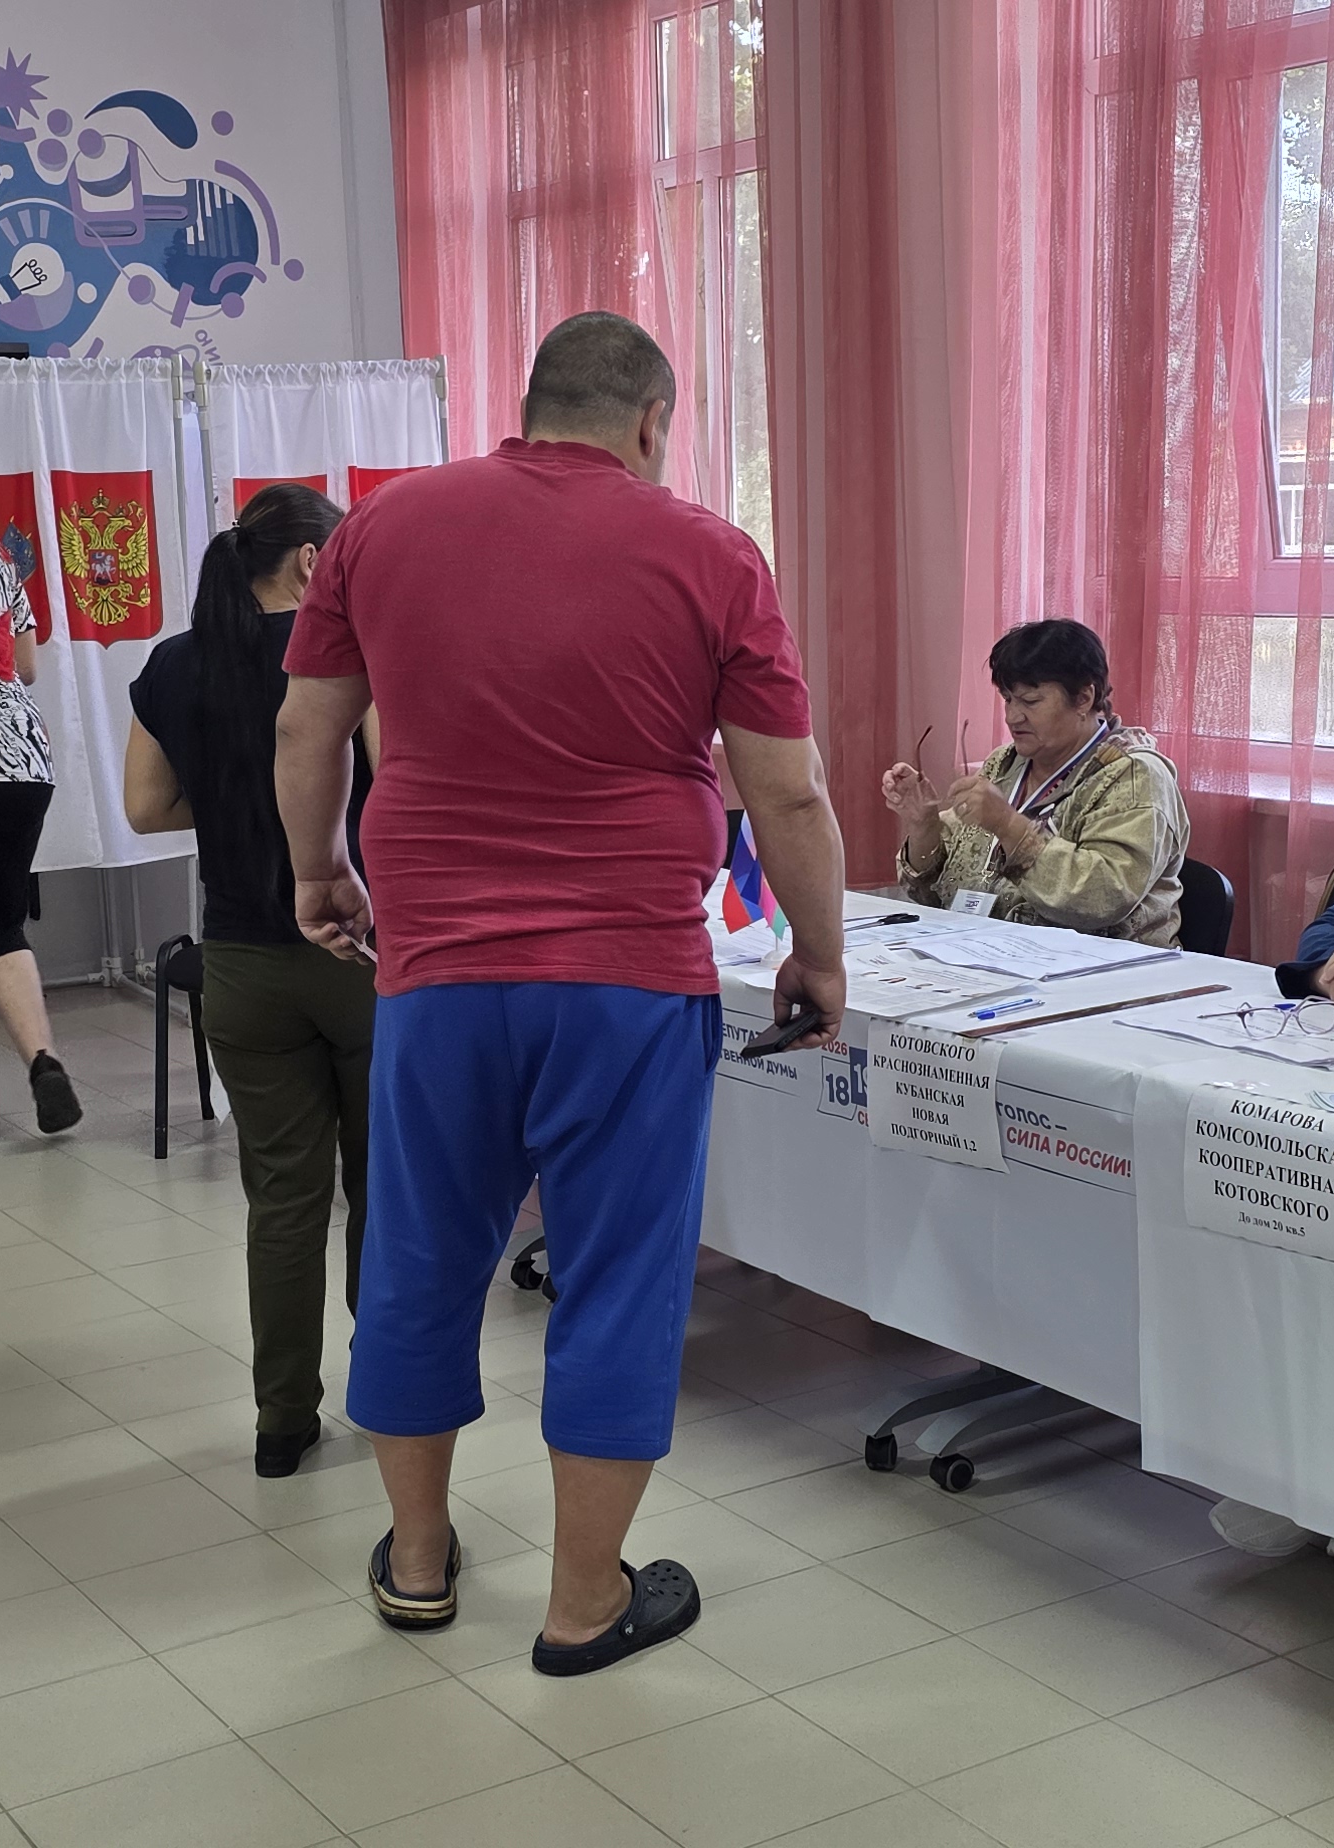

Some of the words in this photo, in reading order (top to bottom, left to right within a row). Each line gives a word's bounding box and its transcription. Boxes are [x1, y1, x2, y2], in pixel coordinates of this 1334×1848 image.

[890, 1034, 975, 1062] КОТОВСКОГО
[767, 1061, 798, 1080] ДУМЫ
[873, 1054, 990, 1089] КРАСНОЗНАМЕННАЯ
[826, 1073, 849, 1106] 18
[896, 1082, 965, 1107] КУБАНСКАЯ
[912, 1107, 949, 1125] НОВАЯ
[1230, 1099, 1325, 1132] КОМАРОВА
[891, 1123, 961, 1148] ПОДГОРНЫЙ
[1007, 1126, 1051, 1155] СИЛА
[1055, 1139, 1132, 1178] РОССИИ!
[1214, 1179, 1329, 1222] КОТОВСКОГО
[1237, 1211, 1251, 1224] До
[1252, 1216, 1271, 1228] дом
[1272, 1219, 1283, 1232] 20
[1285, 1224, 1306, 1237] кв.5
